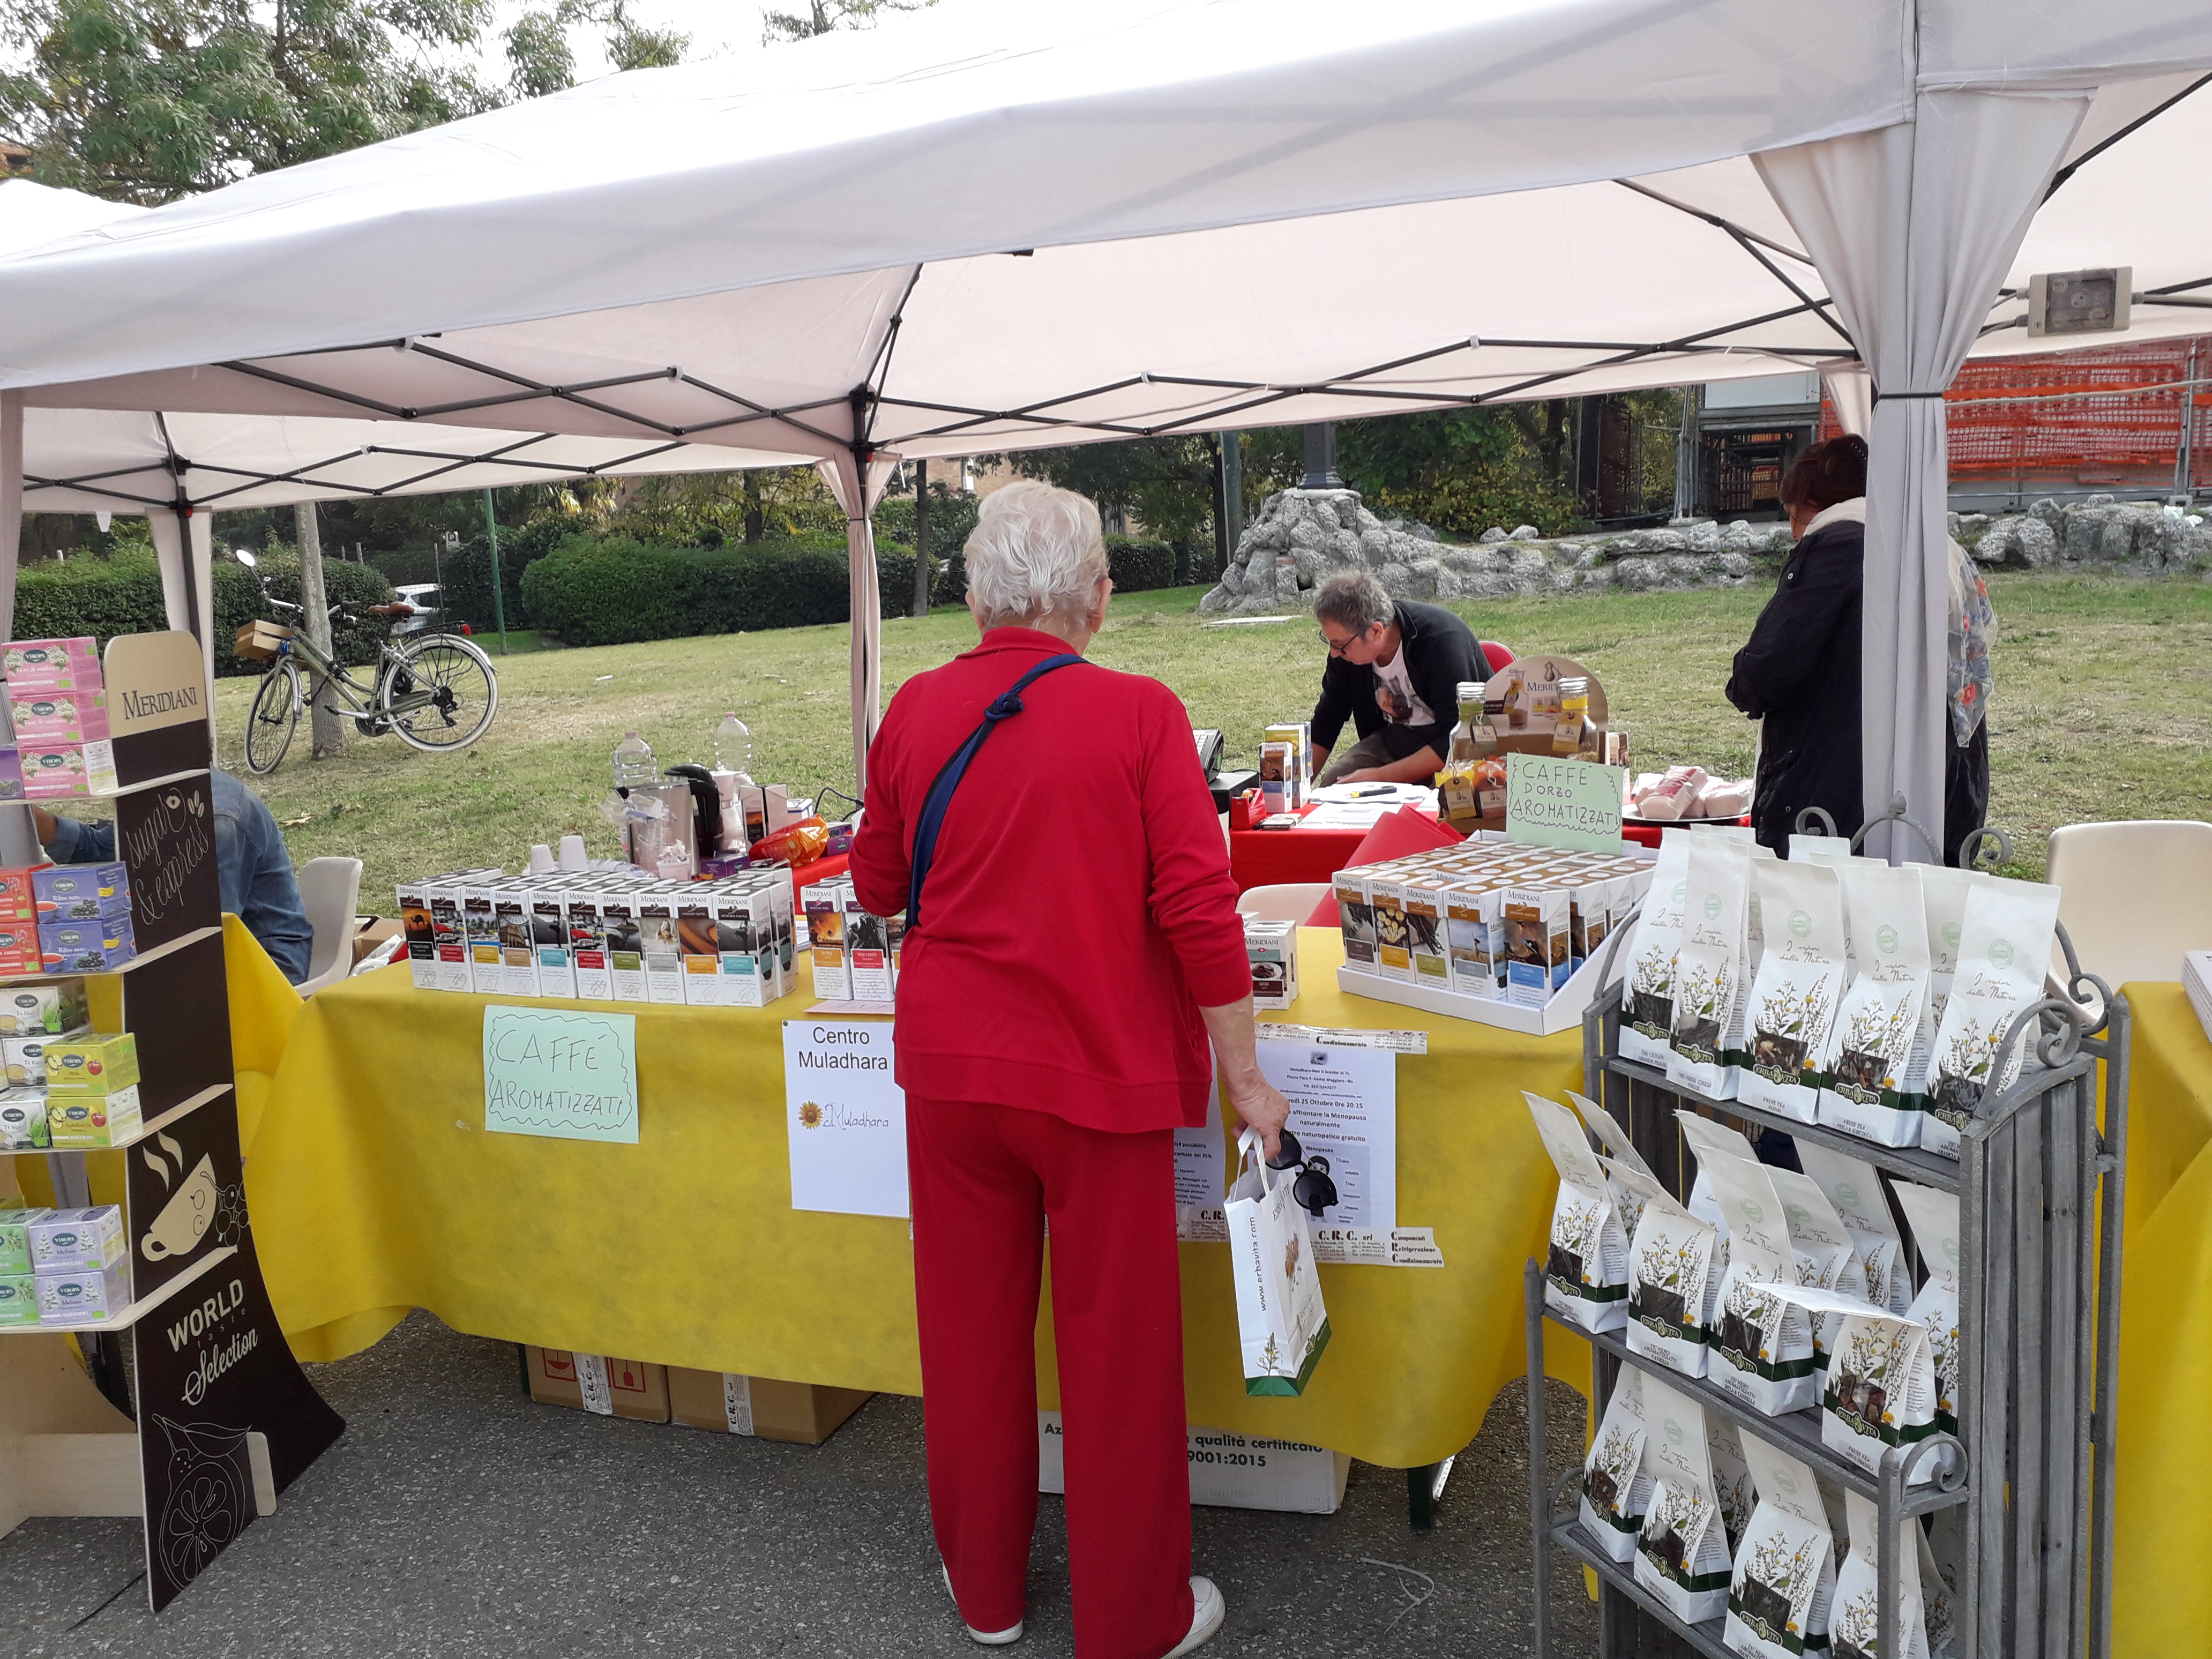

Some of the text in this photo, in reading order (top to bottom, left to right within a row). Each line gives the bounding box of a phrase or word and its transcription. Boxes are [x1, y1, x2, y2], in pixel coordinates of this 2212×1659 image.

[122, 686, 198, 720] MERIDIANI
[1511, 797, 1619, 826] AROMATIZZATI
[126, 788, 186, 872] sugar
[1372, 883, 1399, 893] MERIDIANI
[1407, 889, 1434, 900] MERIDIANI
[1508, 891, 1540, 902] MERIDIANI
[718, 897, 748, 905] MERIDIANI
[1449, 893, 1478, 904] MERIDIANI
[813, 1027, 870, 1045] Centro
[799, 1051, 888, 1070] Muladhara
[1678, 1047, 1712, 1062] ERBA VITA
[1756, 1066, 1797, 1083] ERBA VITA
[491, 1079, 624, 1116] AROMATIZZATI
[1310, 1099, 1334, 1107] Ottobre
[1763, 1097, 1785, 1109] FRUIT TEA
[1837, 1086, 1877, 1103] ERBA VITA
[823, 1102, 890, 1131] Muladhara
[1292, 1109, 1322, 1117] affrontare
[1331, 1112, 1367, 1121] Menopausa
[1938, 1111, 1956, 1125] ERBA
[1299, 1120, 1340, 1129] naturalmente
[1843, 1118, 1865, 1131] FRUIT TEA
[1302, 1132, 1340, 1140] naturopatico
[1305, 1145, 1334, 1154] Menopausa
[1249, 1216, 1267, 1312] www.erbavita.com
[167, 1279, 244, 1352] WORLD
[197, 1307, 246, 1350] taste
[1642, 1318, 1679, 1338] ERBA VITA
[181, 1327, 258, 1406] Selection
[1722, 1348, 1755, 1372] ERBA VITA
[1839, 1410, 1877, 1438] ERBA VITA
[1195, 1433, 1245, 1449] qualità
[1848, 1446, 1871, 1463] FRUIT TEA
[1648, 1552, 1676, 1581] ERBA VITA
[1742, 1614, 1780, 1644] ERBA VITA
